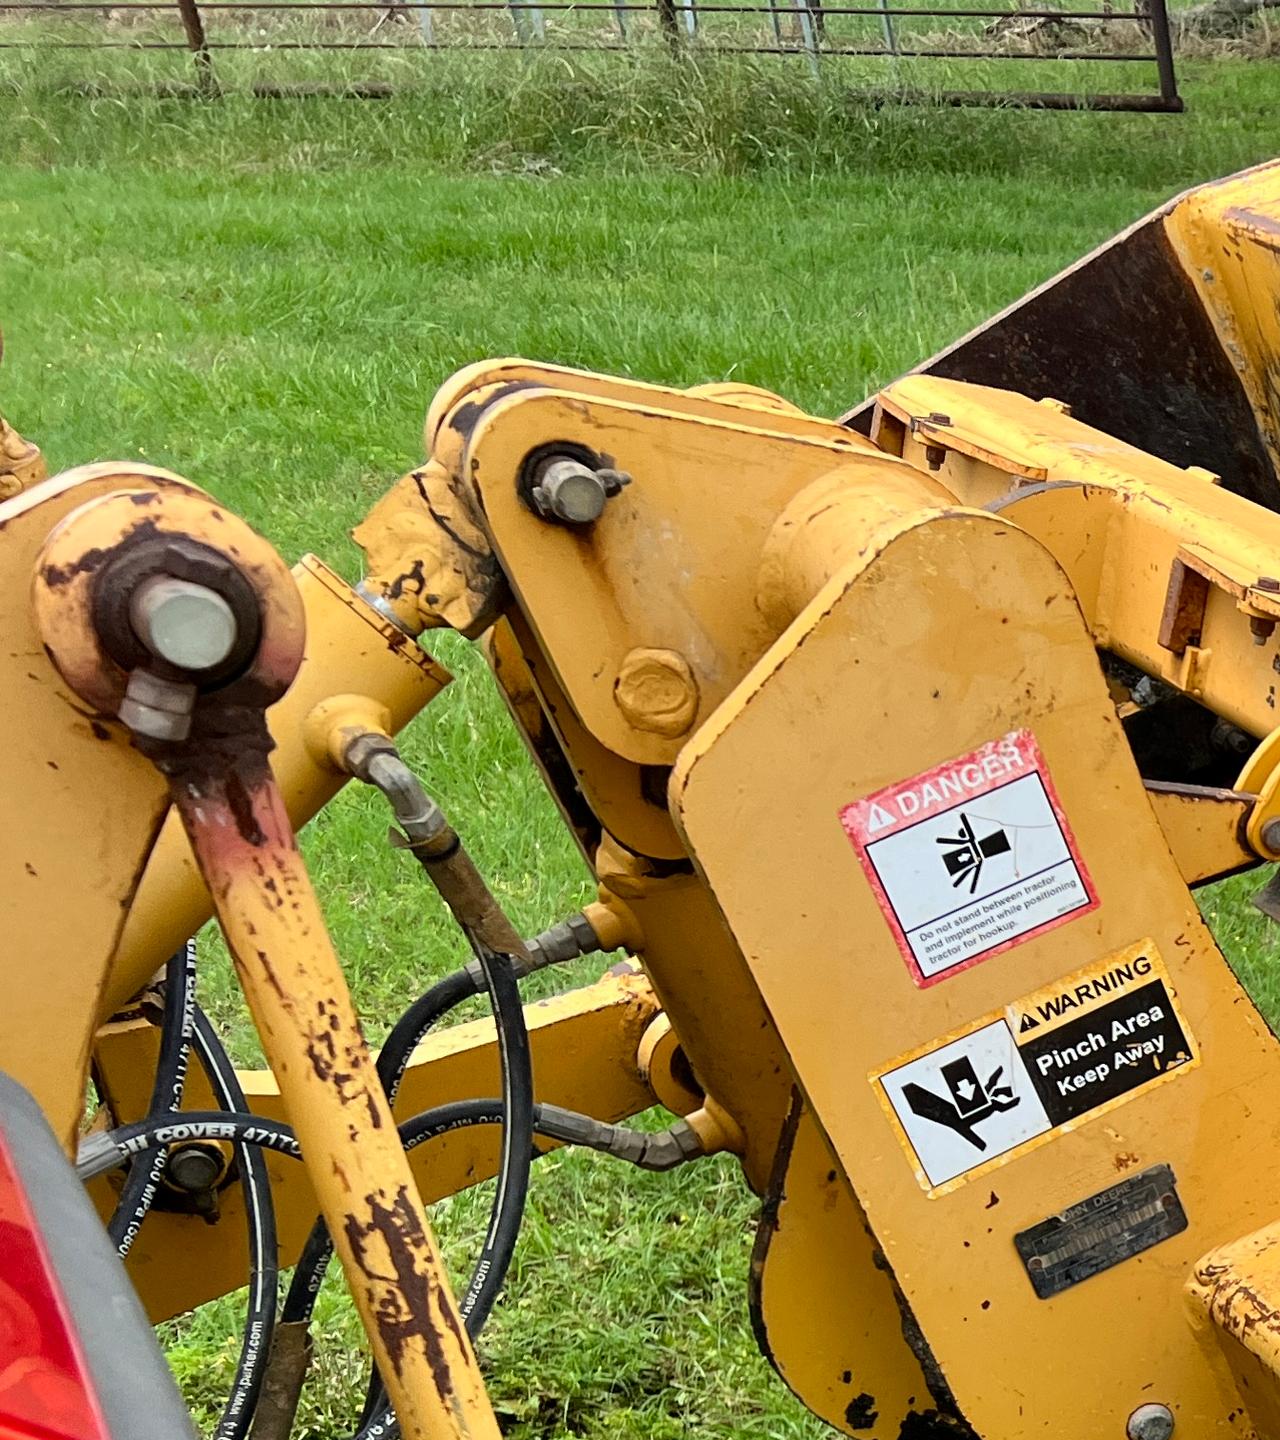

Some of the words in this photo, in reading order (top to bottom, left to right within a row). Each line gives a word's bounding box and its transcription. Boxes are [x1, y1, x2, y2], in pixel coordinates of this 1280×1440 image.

[896, 745, 1024, 817] DANGER
[919, 931, 934, 943] Do
[935, 921, 953, 935] not
[953, 908, 982, 928] stand
[983, 890, 1023, 914] between
[1023, 874, 1056, 895] tractor
[924, 938, 944, 954] and
[944, 915, 996, 946] implement
[996, 903, 1023, 921] while
[1024, 879, 1078, 911] positioning
[928, 945, 962, 965] tractor
[962, 937, 977, 950] for
[1036, 956, 1152, 1023] WARNING
[1036, 1032, 1108, 1077] Pinch
[1111, 1004, 1165, 1043] Area
[1056, 1061, 1111, 1097] Keep
[1113, 1034, 1165, 1071] Away
[149, 1146, 169, 1183] 40.0
[154, 1122, 239, 1143] COVER
[134, 1183, 157, 1218] MPa
[1093, 1181, 1133, 1208] DEERE
[229, 1321, 264, 1416] www.parker.com
